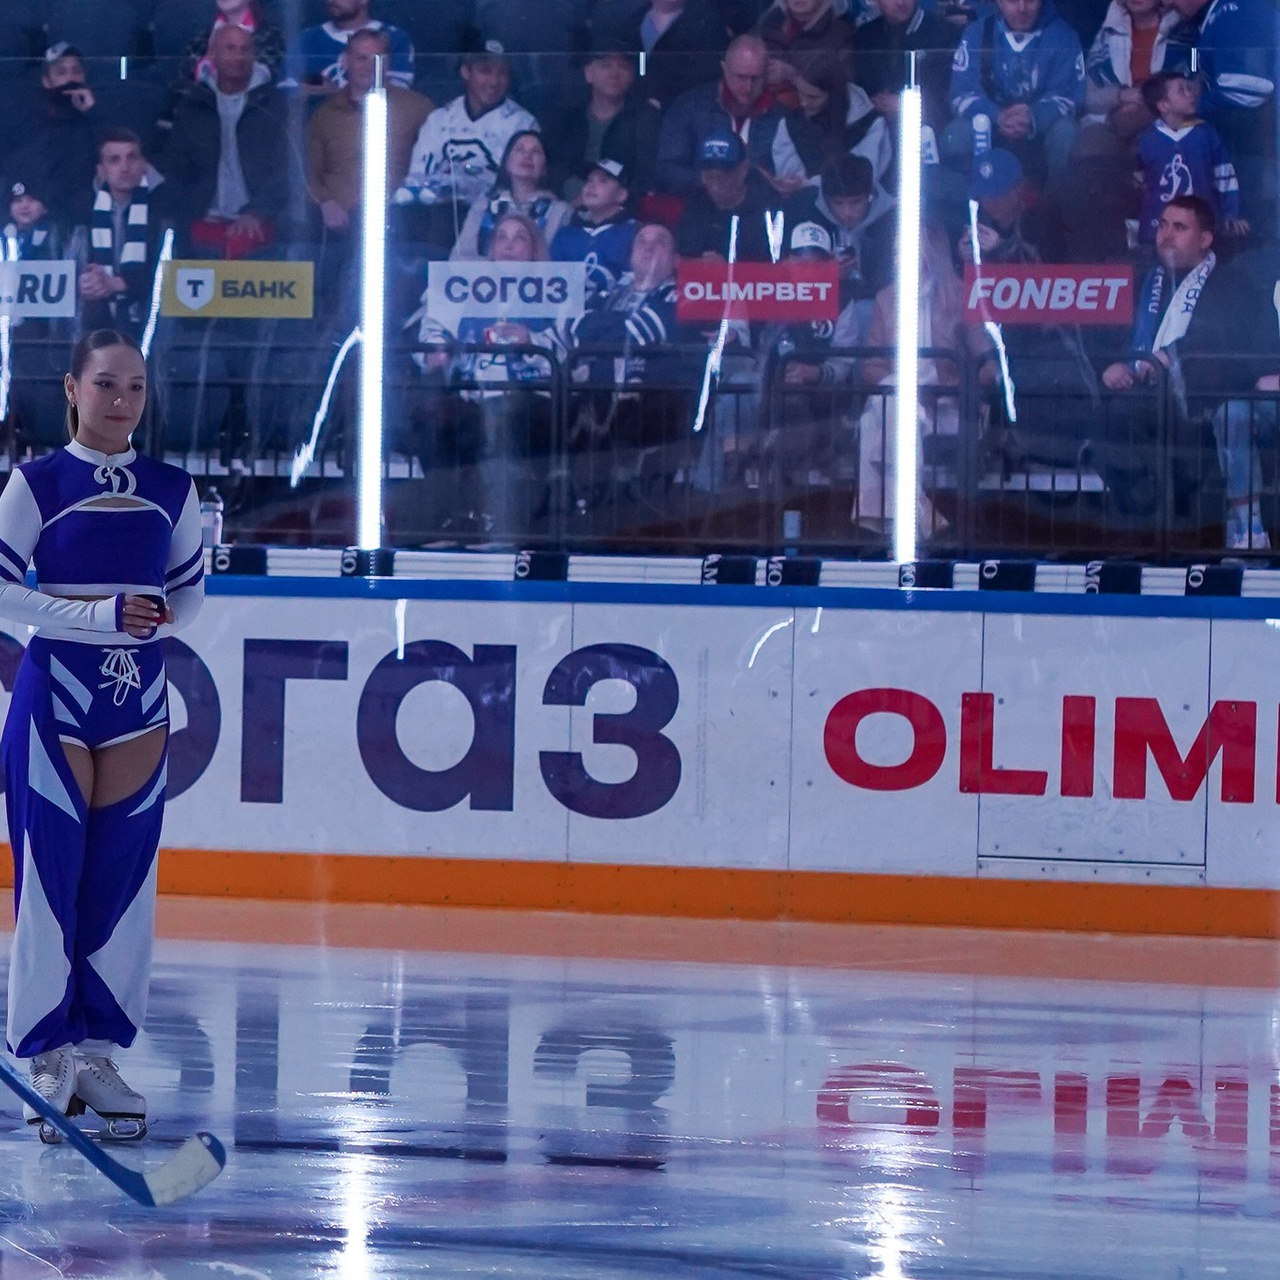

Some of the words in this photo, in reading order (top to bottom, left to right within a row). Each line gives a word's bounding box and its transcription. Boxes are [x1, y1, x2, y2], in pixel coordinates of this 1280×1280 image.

[221, 279, 296, 299] БАНК
[684, 281, 833, 302] OLIMPBET
[967, 277, 1129, 311] FONBET
[823, 687, 1280, 806] OLIM
